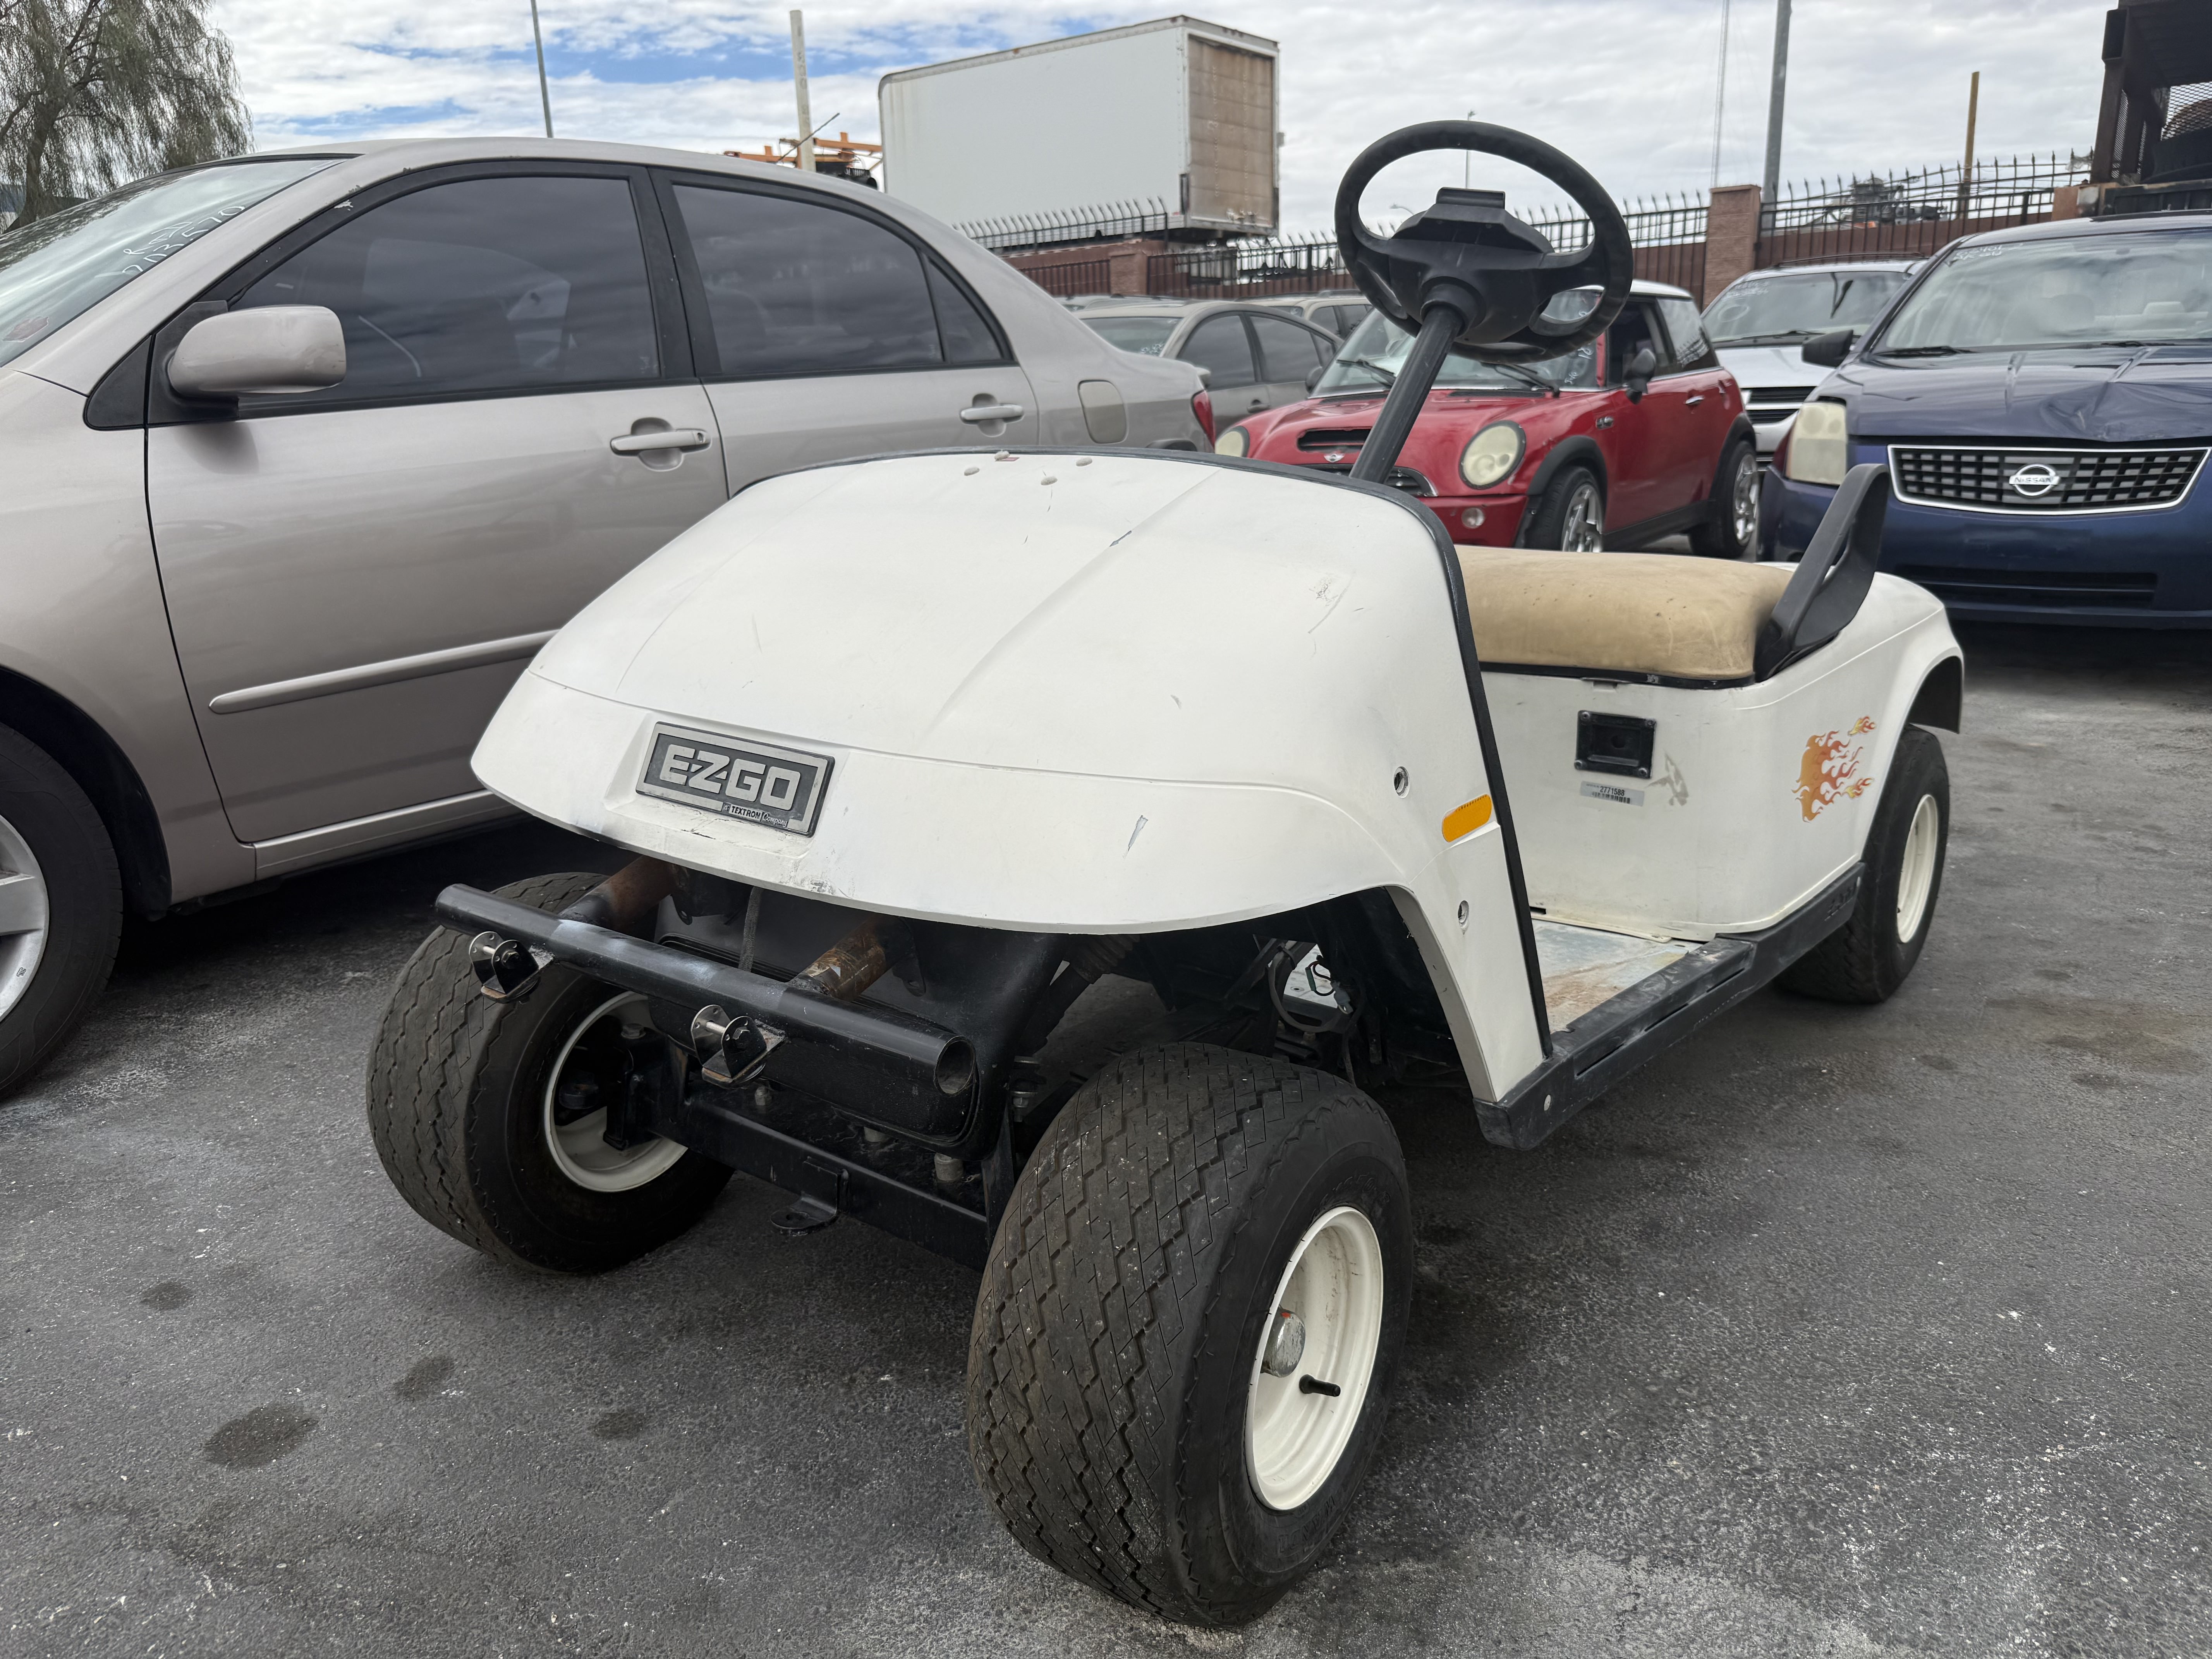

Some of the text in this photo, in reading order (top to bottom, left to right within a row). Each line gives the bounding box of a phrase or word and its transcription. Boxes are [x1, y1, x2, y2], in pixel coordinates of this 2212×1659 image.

[1600, 786, 1625, 796] 2771588
[731, 806, 761, 819] TEXTRON
[763, 812, 788, 828] Company
